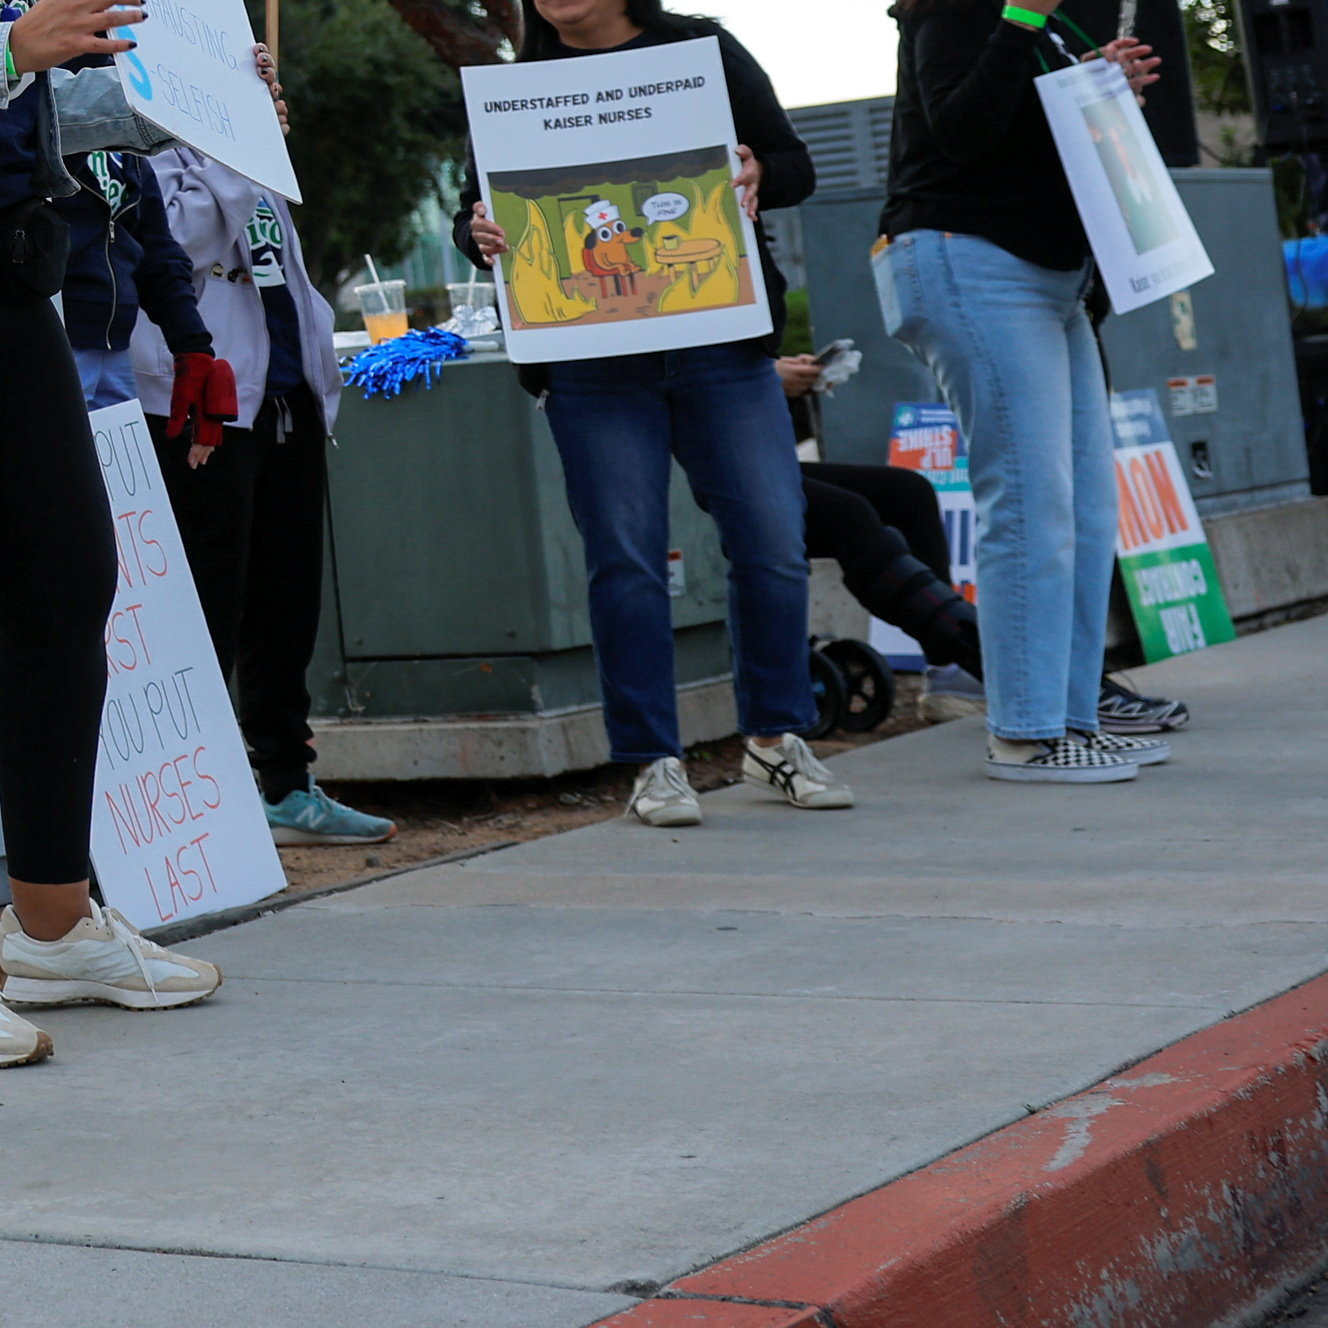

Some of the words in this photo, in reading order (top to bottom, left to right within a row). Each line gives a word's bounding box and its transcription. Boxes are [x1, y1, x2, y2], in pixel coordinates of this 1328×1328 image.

[484, 93, 590, 113] UNDERSTAFFED
[596, 88, 623, 103] AND
[628, 76, 705, 99] UNDERPAID
[544, 114, 593, 131] KAISER
[599, 107, 652, 125] NURSES
[94, 421, 153, 502] PUT
[145, 667, 201, 751] PUT
[104, 746, 221, 856] NURSES
[144, 833, 218, 922] LAST
